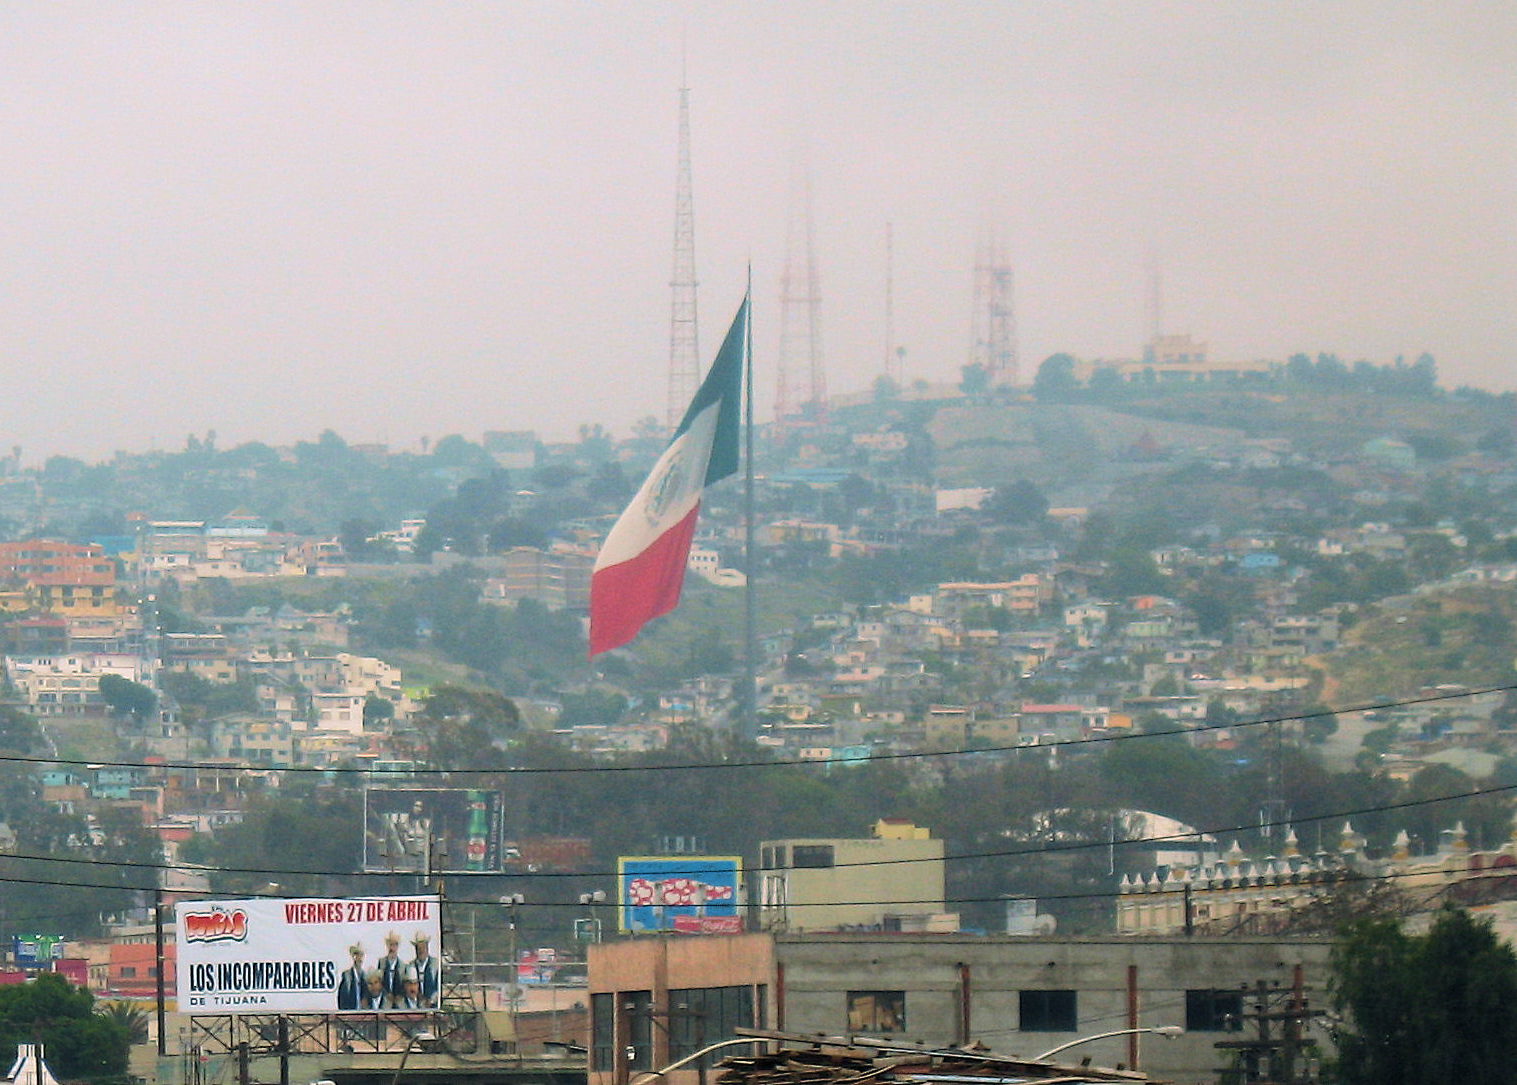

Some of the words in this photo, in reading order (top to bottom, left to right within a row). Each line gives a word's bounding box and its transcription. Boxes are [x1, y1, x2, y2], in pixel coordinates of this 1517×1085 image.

[285, 902, 343, 924] VIERNES
[348, 903, 362, 923] 27
[366, 902, 383, 922] DE
[387, 901, 430, 921] ABRIL
[189, 963, 215, 992] LOS
[217, 960, 336, 990] INCOMPARABLES
[190, 997, 206, 1006] DE
[214, 996, 267, 1006] TIJUANA
